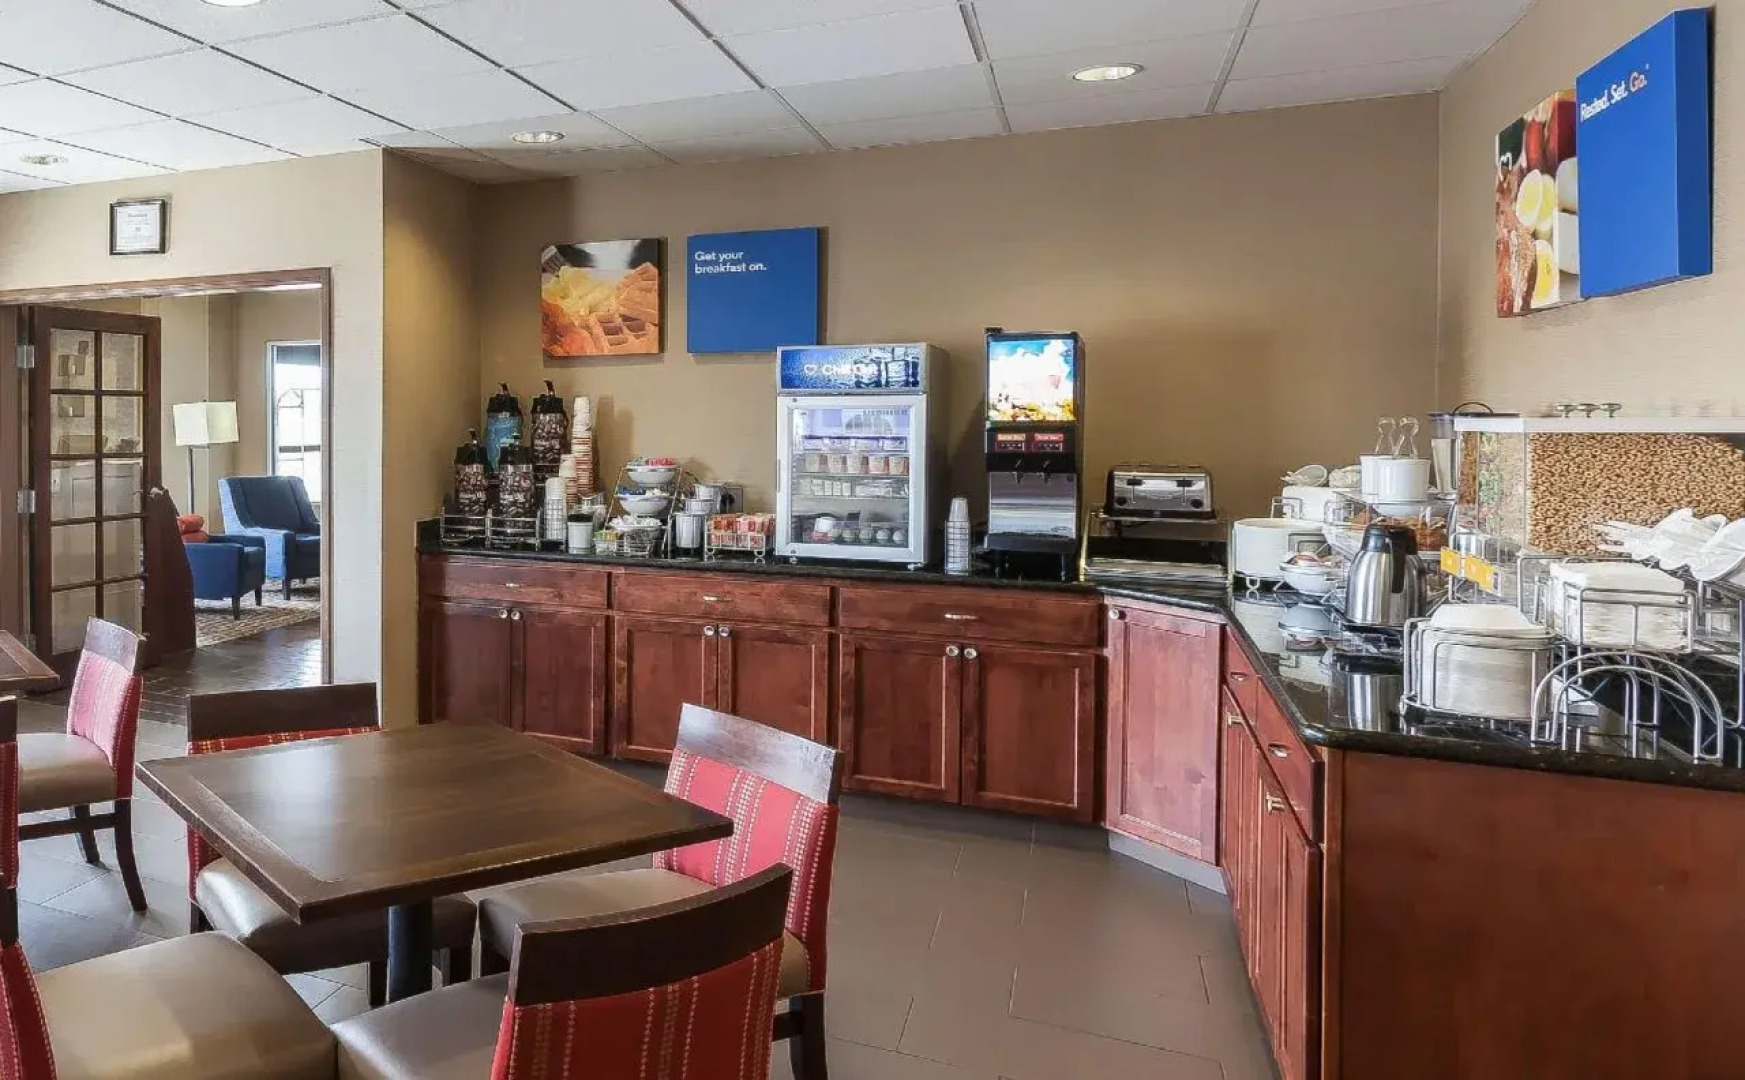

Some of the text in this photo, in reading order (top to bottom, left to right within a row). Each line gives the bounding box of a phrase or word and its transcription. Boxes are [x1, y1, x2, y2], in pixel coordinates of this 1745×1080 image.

[1580, 71, 1647, 122] Rested. Set. Go.
[695, 251, 744, 262] Get your
[695, 263, 767, 274] breakfast on.
